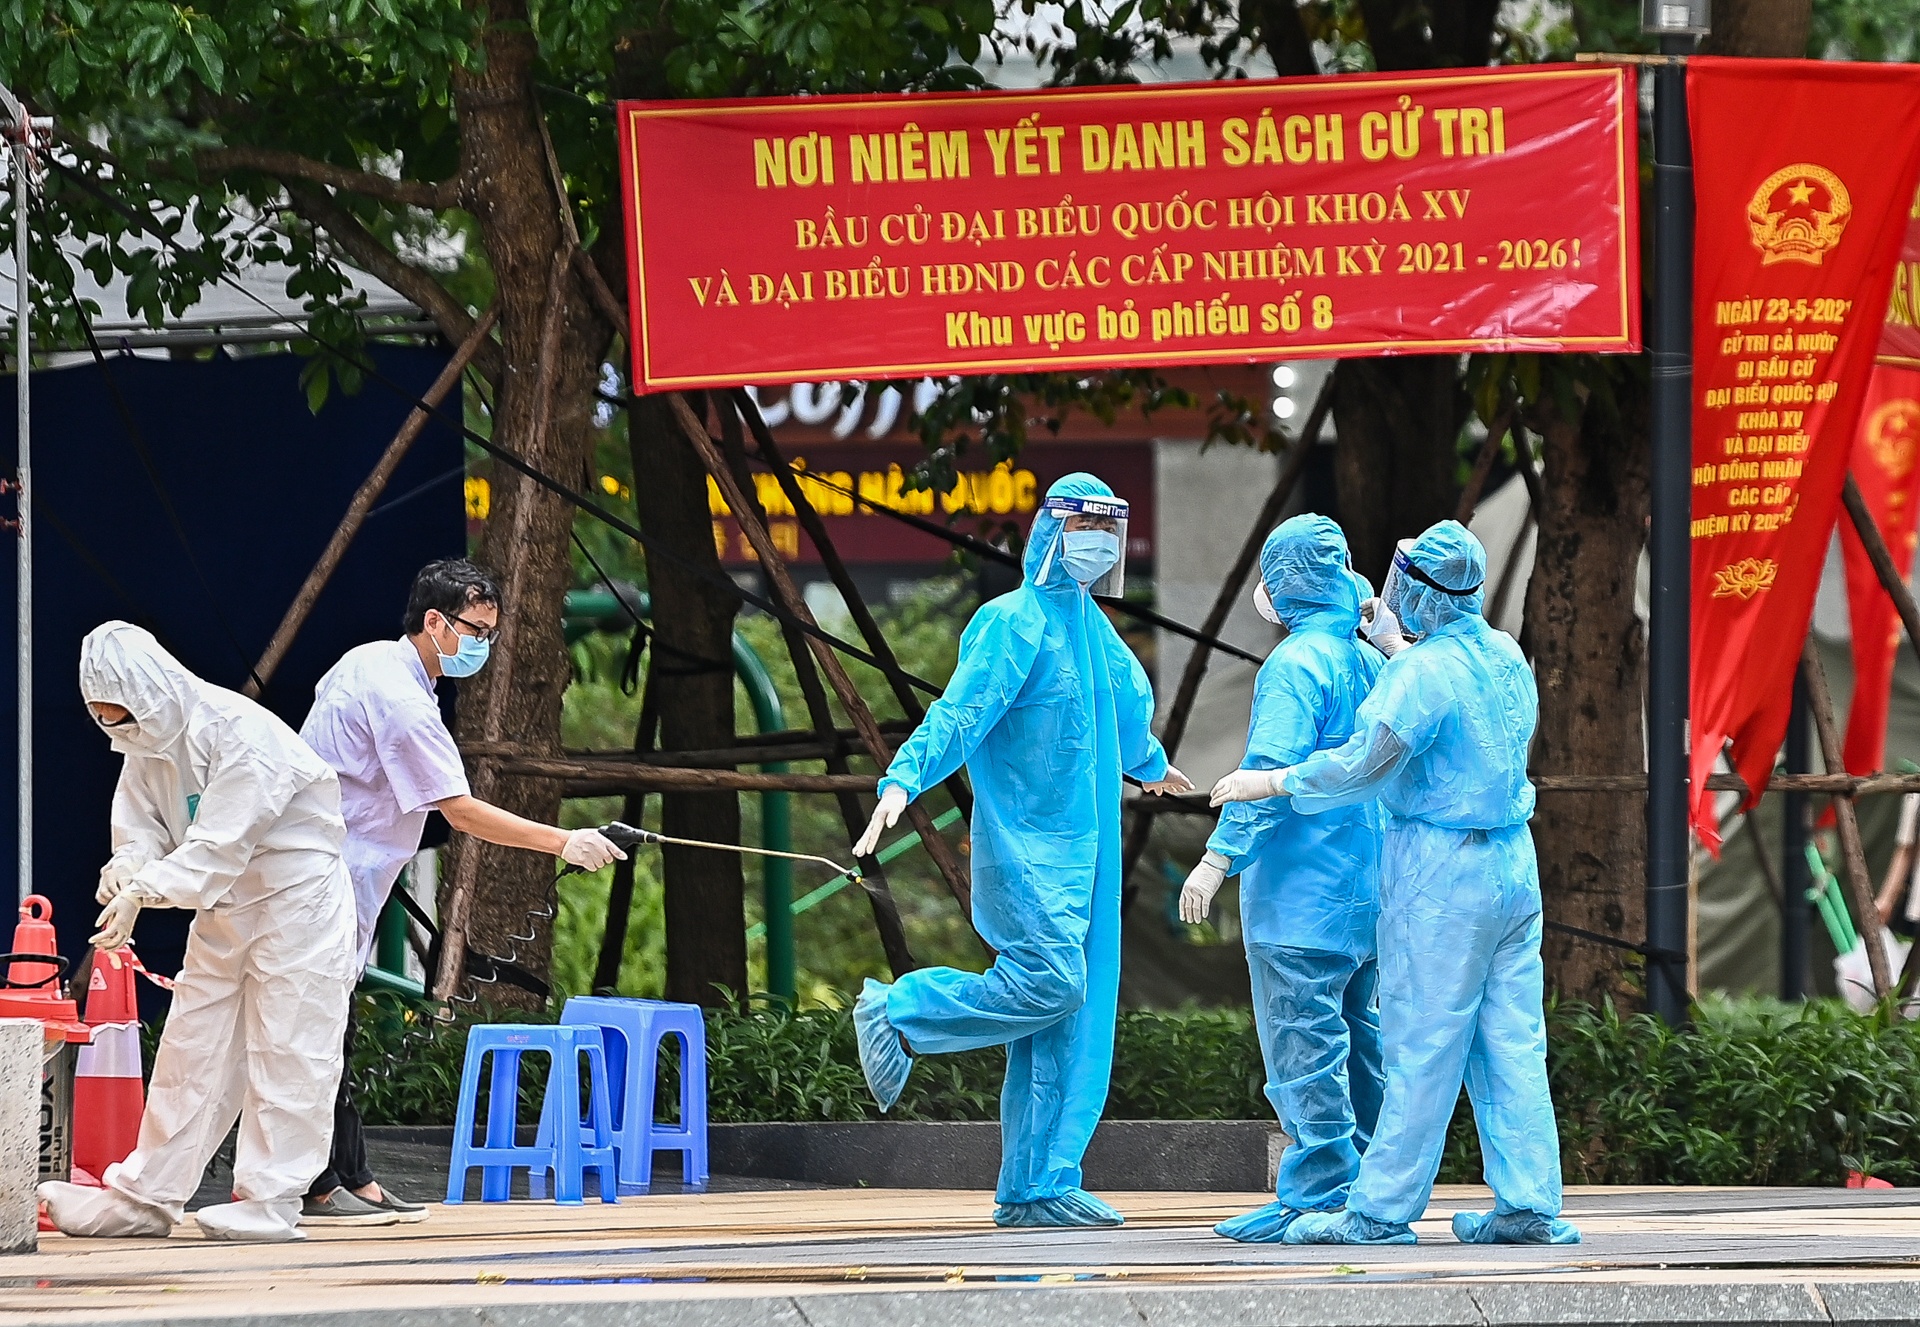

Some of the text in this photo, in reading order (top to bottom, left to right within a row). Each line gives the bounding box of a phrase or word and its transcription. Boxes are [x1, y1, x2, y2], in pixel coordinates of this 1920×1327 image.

[754, 95, 1505, 188] NƠI NIÊM YẾT DANH SÁCH CỬ TRI
[796, 186, 1470, 249] BẦU CỬ ĐẠI BIỂU QUỐC HỘI KHOÁ XV
[690, 239, 1580, 308] VÀ ĐẠI BIỂU HĐND CÁC CẤP NHIỆM KỲ 2021 - 2026!
[946, 290, 1333, 351] Khu vực bỏ phiếu số 8
[1716, 295, 1764, 325] NGÀY
[1722, 330, 1745, 355] CỬ
[1744, 335, 1769, 352] TRI
[1771, 328, 1793, 353] CẢ
[1737, 353, 1817, 379] ĐI BẦU CỬ
[1705, 388, 1731, 409] ĐẠI
[1733, 379, 1769, 405] BIỂU
[1771, 380, 1813, 405] QUỐC
[1737, 409, 1803, 430] KHÓA XV
[1725, 433, 1744, 455] VÀ
[1746, 436, 1773, 456] ĐẠI
[1692, 463, 1716, 486] HỘI
[1718, 458, 1759, 481] ĐỒNG
[1729, 485, 1759, 506] CÁC
[1730, 511, 1751, 532] KỲ
